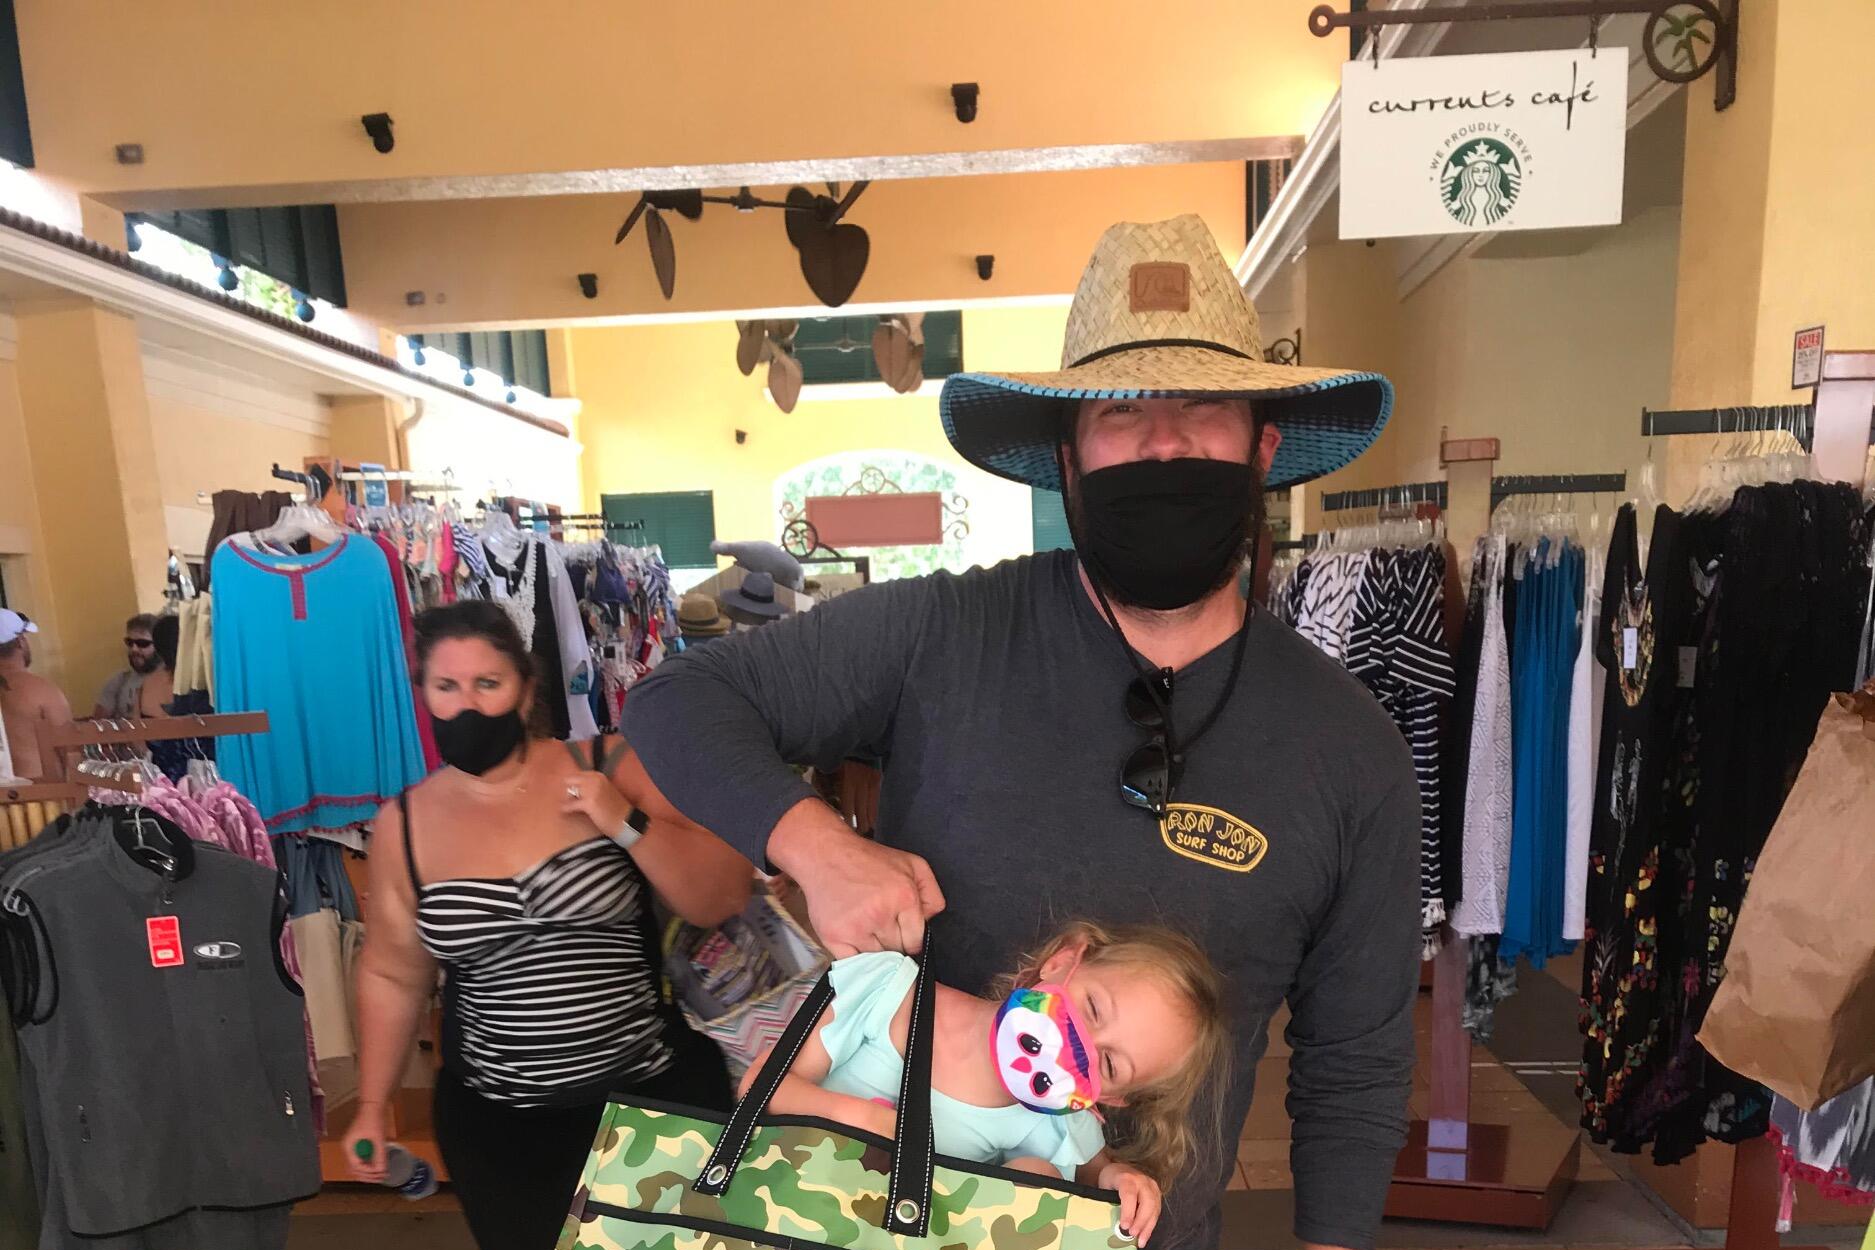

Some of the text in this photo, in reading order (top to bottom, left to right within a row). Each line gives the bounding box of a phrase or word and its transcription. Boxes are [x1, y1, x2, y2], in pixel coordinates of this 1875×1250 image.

[1368, 60, 1600, 131] currents café
[1430, 122, 1533, 170] WE PROUDLY SERVE
[1167, 811, 1261, 855] RON JON
[1176, 832, 1245, 863] SURF SHOP
